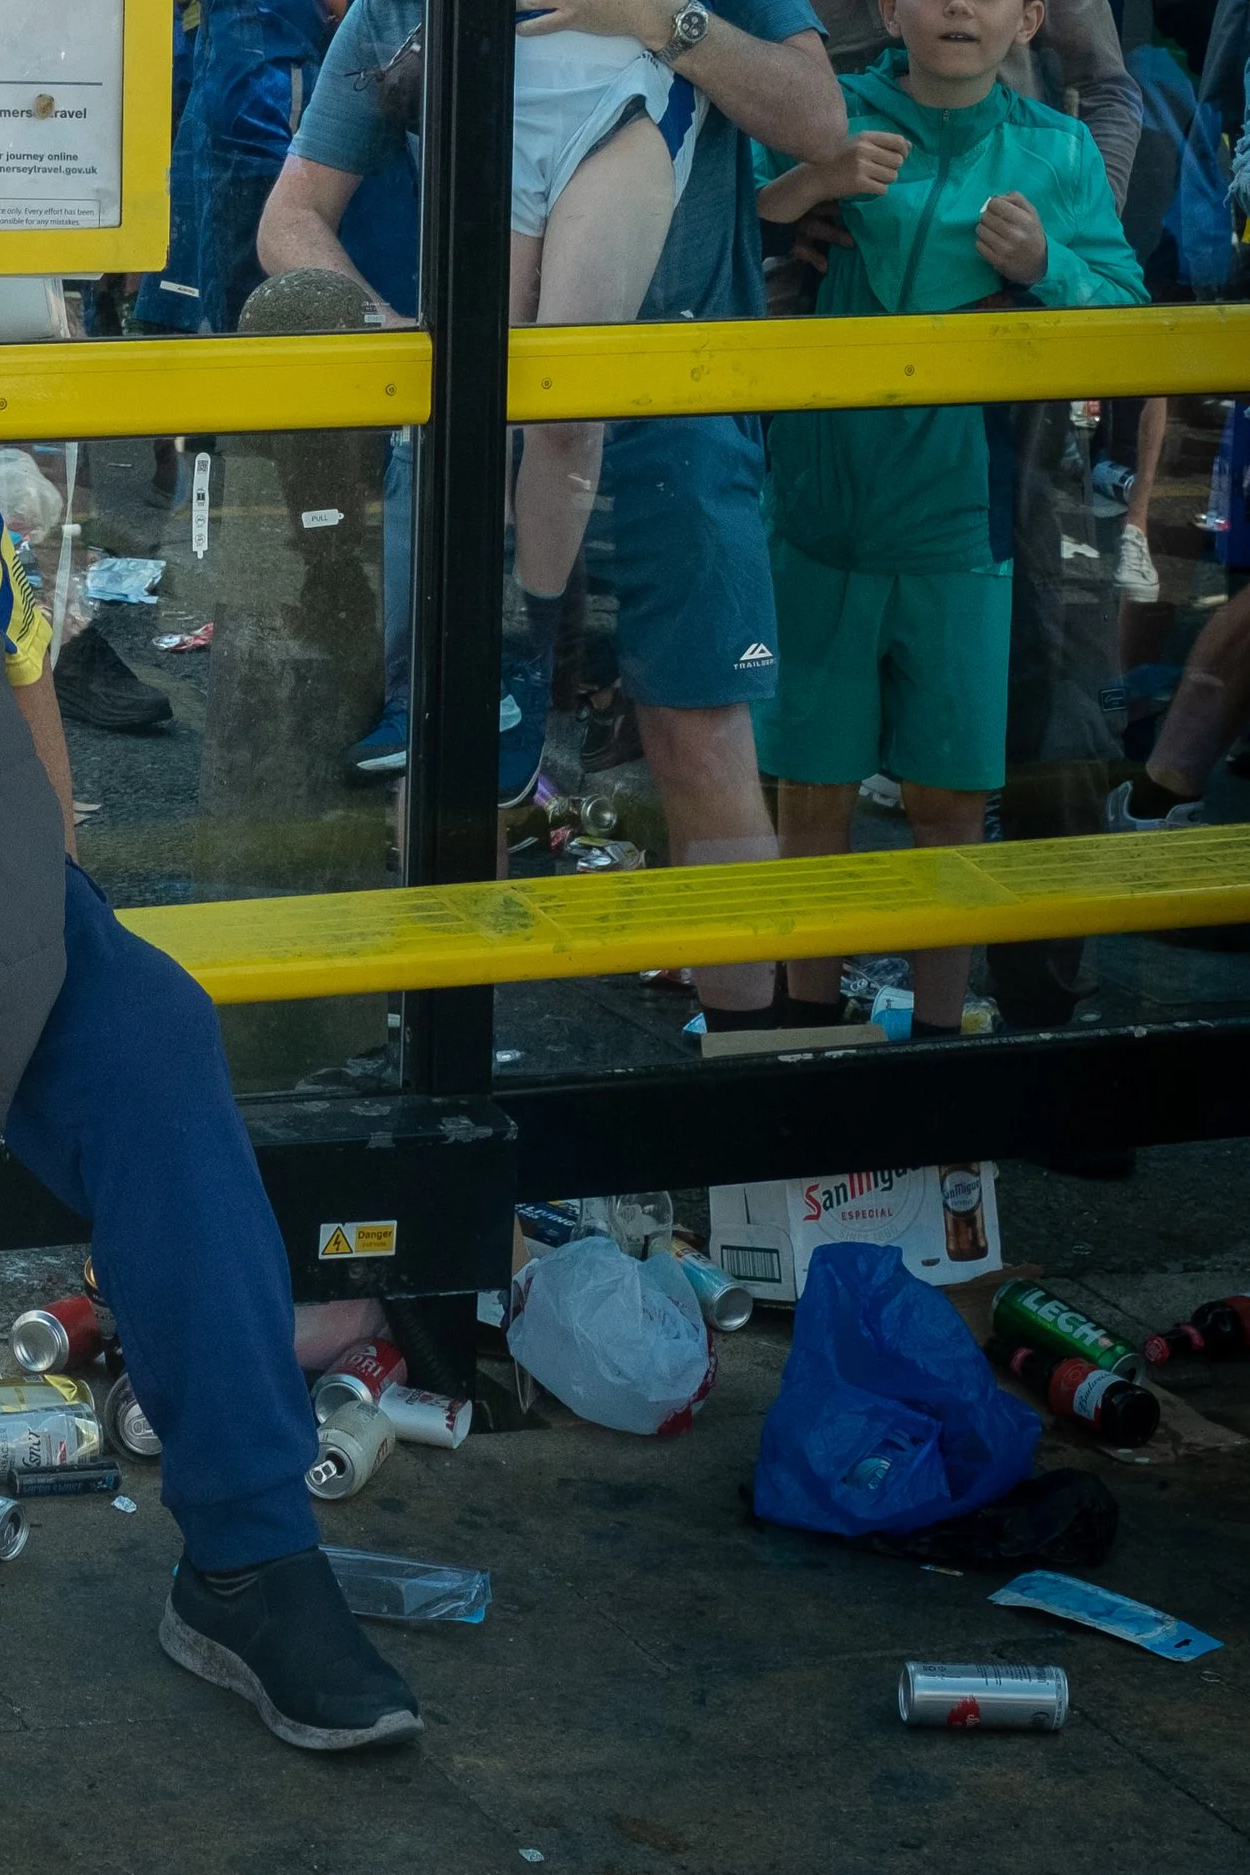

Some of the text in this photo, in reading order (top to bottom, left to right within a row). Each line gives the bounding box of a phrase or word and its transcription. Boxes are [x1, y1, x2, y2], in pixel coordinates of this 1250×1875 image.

[5, 152, 44, 162] journey
[46, 151, 78, 161] online
[311, 514, 329, 523] PULL
[841, 1208, 893, 1222] ESPECIAL
[357, 1230, 393, 1241] Danger
[1022, 1290, 1109, 1345] LECH
